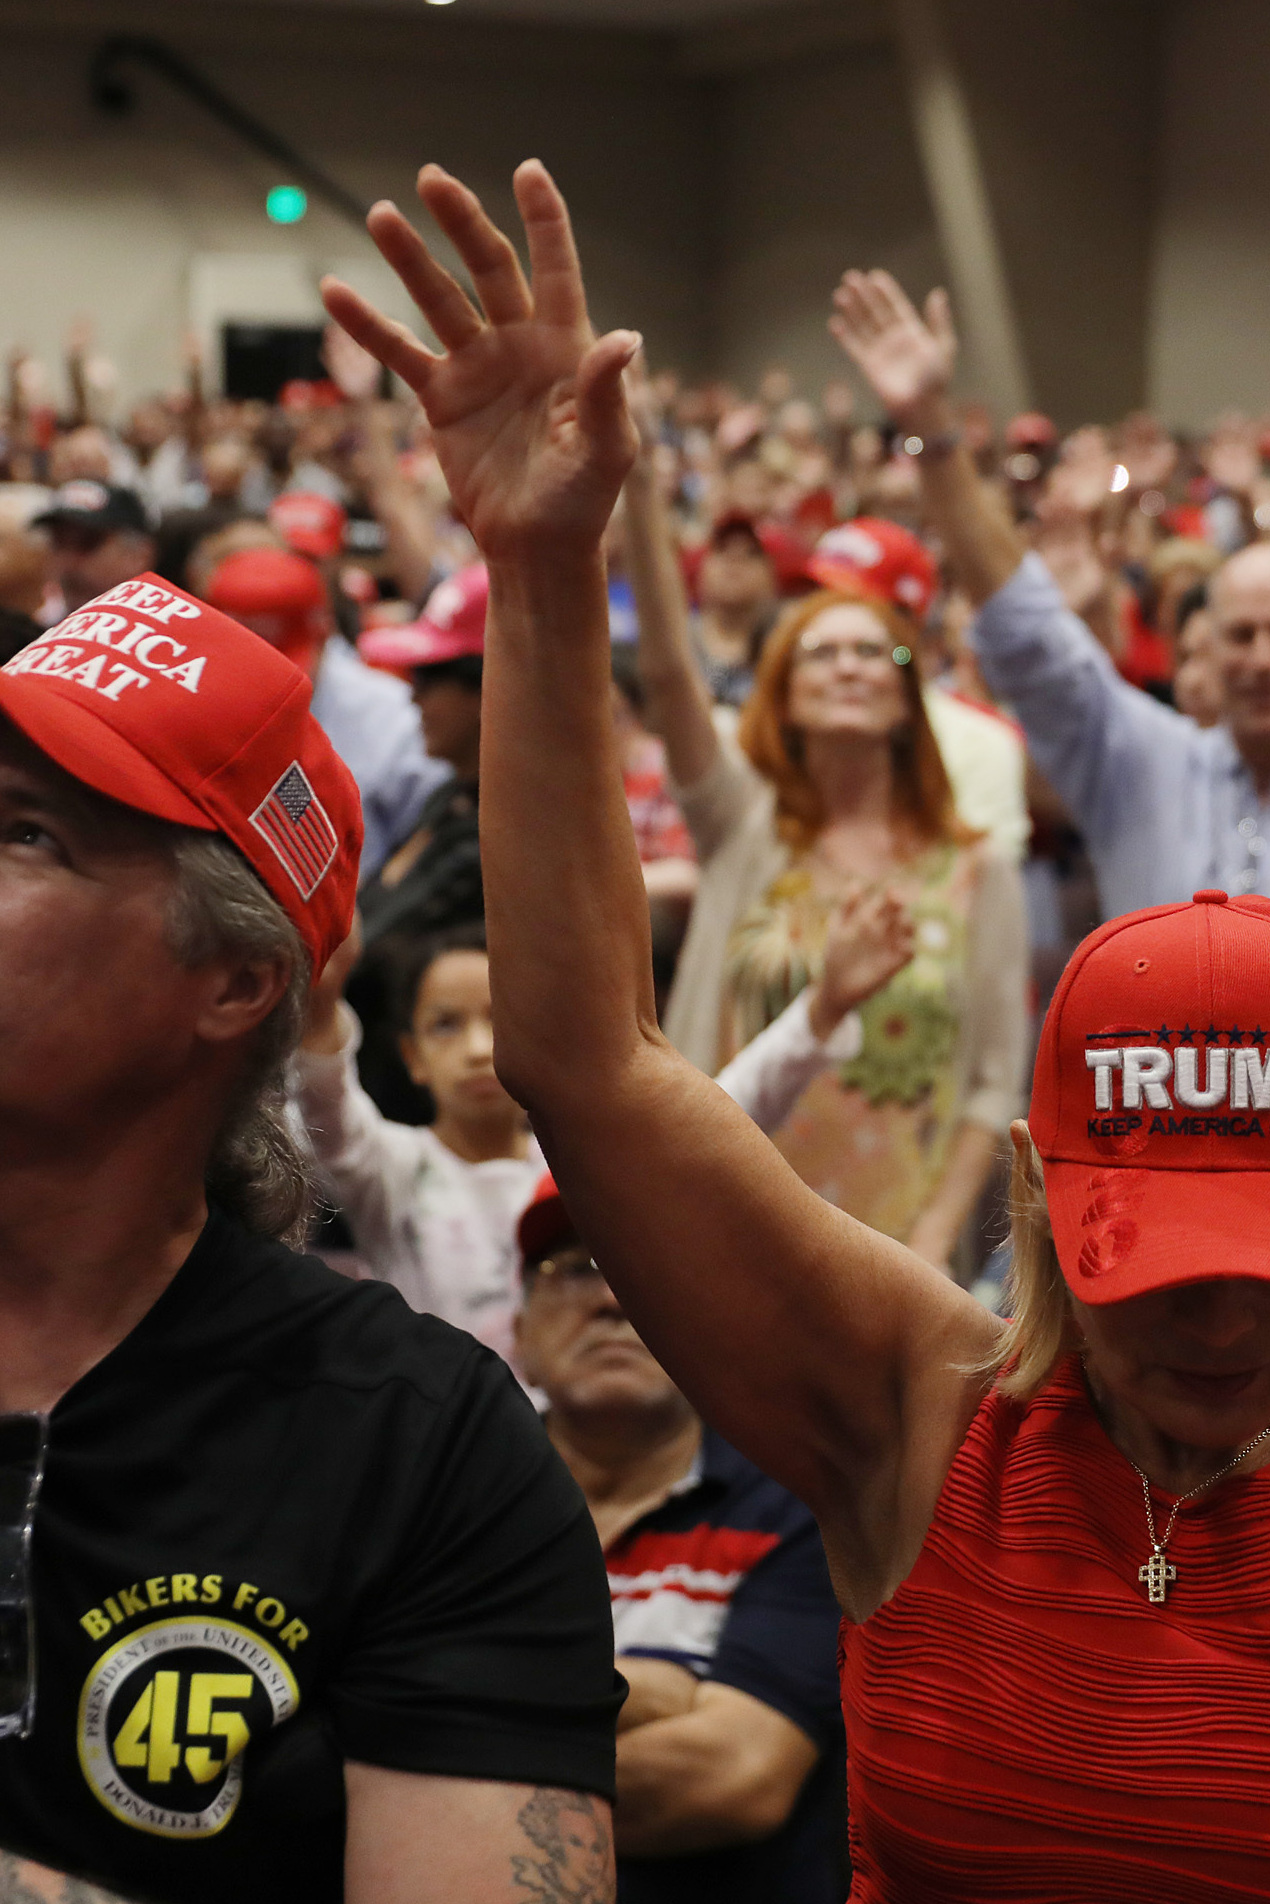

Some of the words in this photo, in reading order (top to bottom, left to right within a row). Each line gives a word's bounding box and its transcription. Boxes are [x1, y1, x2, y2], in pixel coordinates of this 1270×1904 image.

[68, 580, 202, 625] EEP
[1087, 1116, 1143, 1139] KEEP
[1150, 1115, 1265, 1139] AMERICA
[79, 1573, 223, 1641] BIKERS
[232, 1582, 310, 1651] FOR
[86, 1637, 150, 1738] PRESIDENT
[203, 1627, 272, 1673] UNITED
[113, 1670, 254, 1784] 45
[102, 1779, 187, 1830] DONALD
